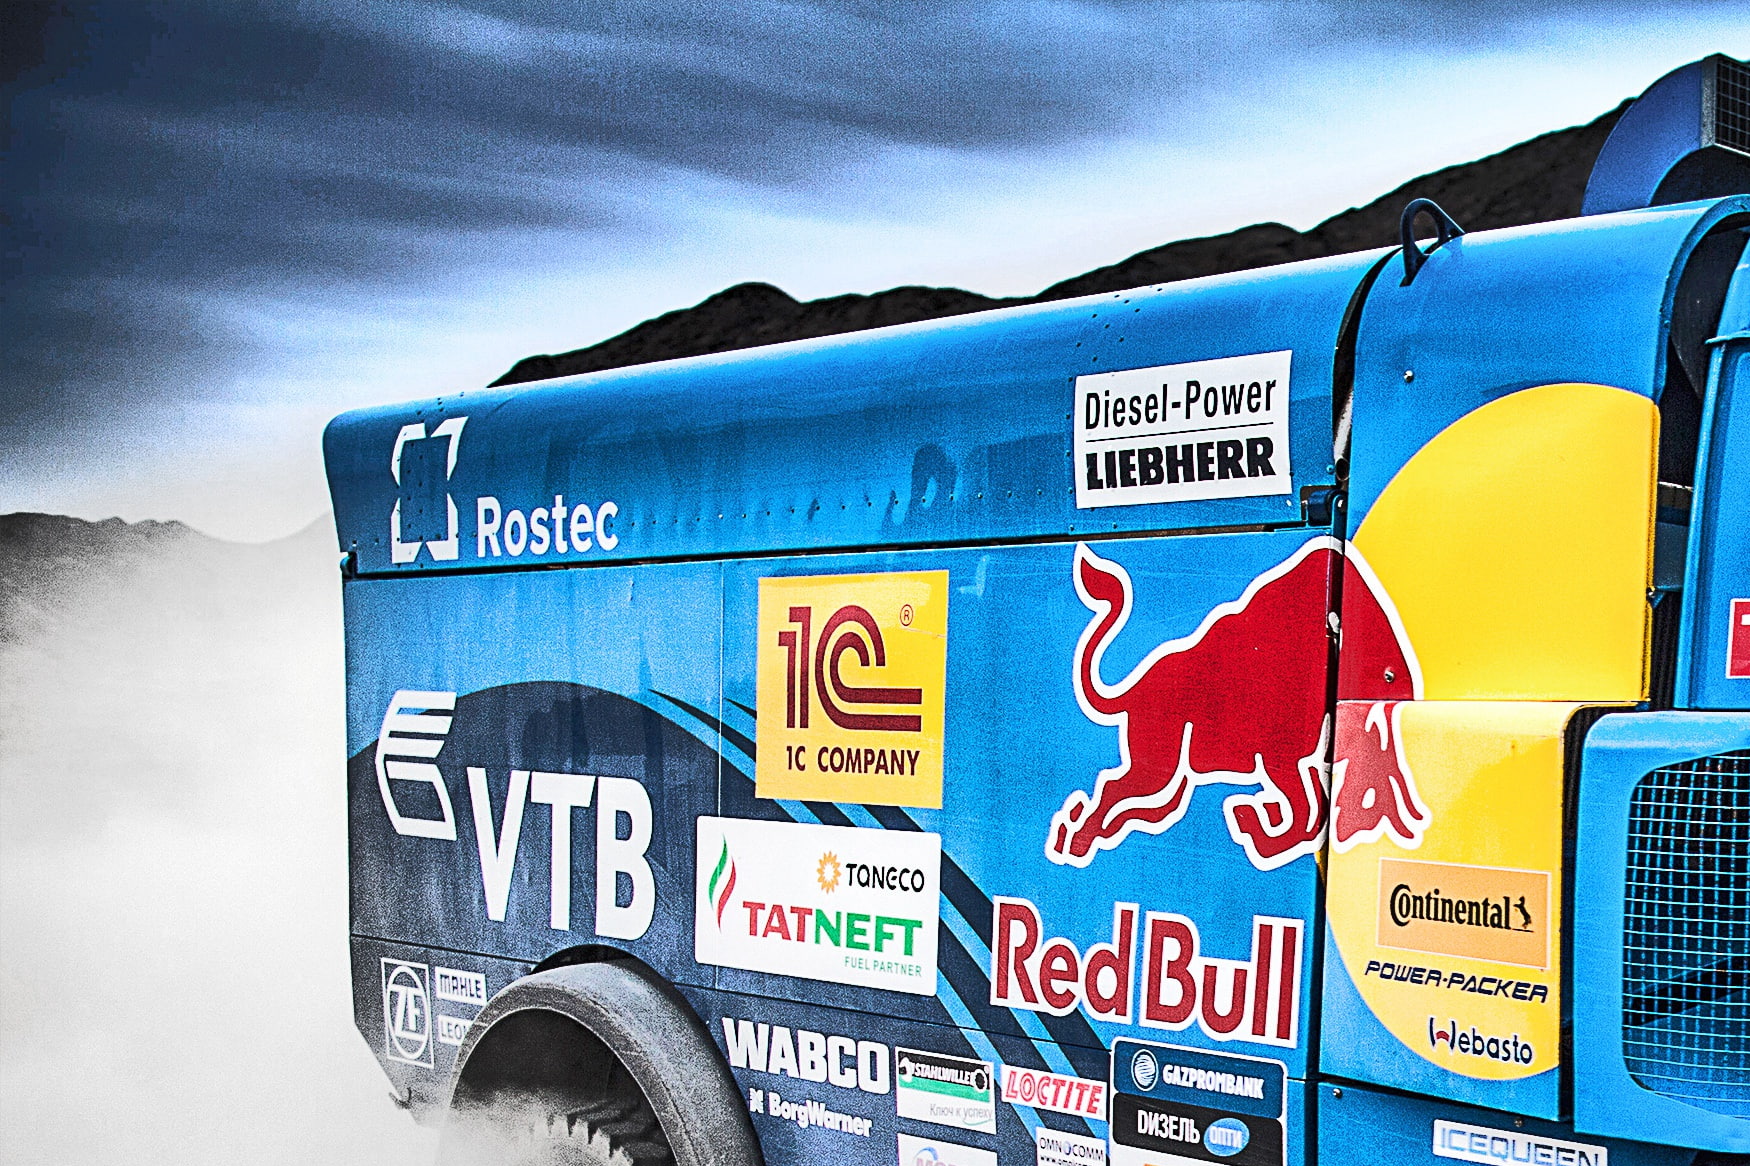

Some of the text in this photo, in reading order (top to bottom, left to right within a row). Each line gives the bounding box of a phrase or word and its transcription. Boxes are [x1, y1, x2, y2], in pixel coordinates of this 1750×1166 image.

[1085, 376, 1277, 430] Diesel-Power
[1086, 437, 1275, 490] LIEBHERR
[477, 493, 619, 557] Rostec
[786, 745, 920, 776] 1C COMPANY
[467, 767, 655, 941] VTB
[846, 863, 925, 892] TANECO
[743, 901, 922, 956] TATNEFT
[1390, 884, 1511, 930] Continental
[440, 974, 482, 999] MAHLE
[845, 956, 922, 977] FUEL PARTNER
[996, 900, 1299, 1042] Red Bull
[1364, 960, 1549, 1003] POWER-PACKER
[389, 983, 426, 1040] ZF
[721, 1017, 890, 1095] WABCO
[1429, 1016, 1533, 1064] Webasto
[914, 1063, 974, 1085] STAHLWILLE
[1006, 1070, 1103, 1114] LOCTITE
[1163, 1064, 1264, 1099] GAZPROMBANK
[769, 1092, 872, 1136] BorgWarner
[930, 1103, 953, 1117] Ключ
